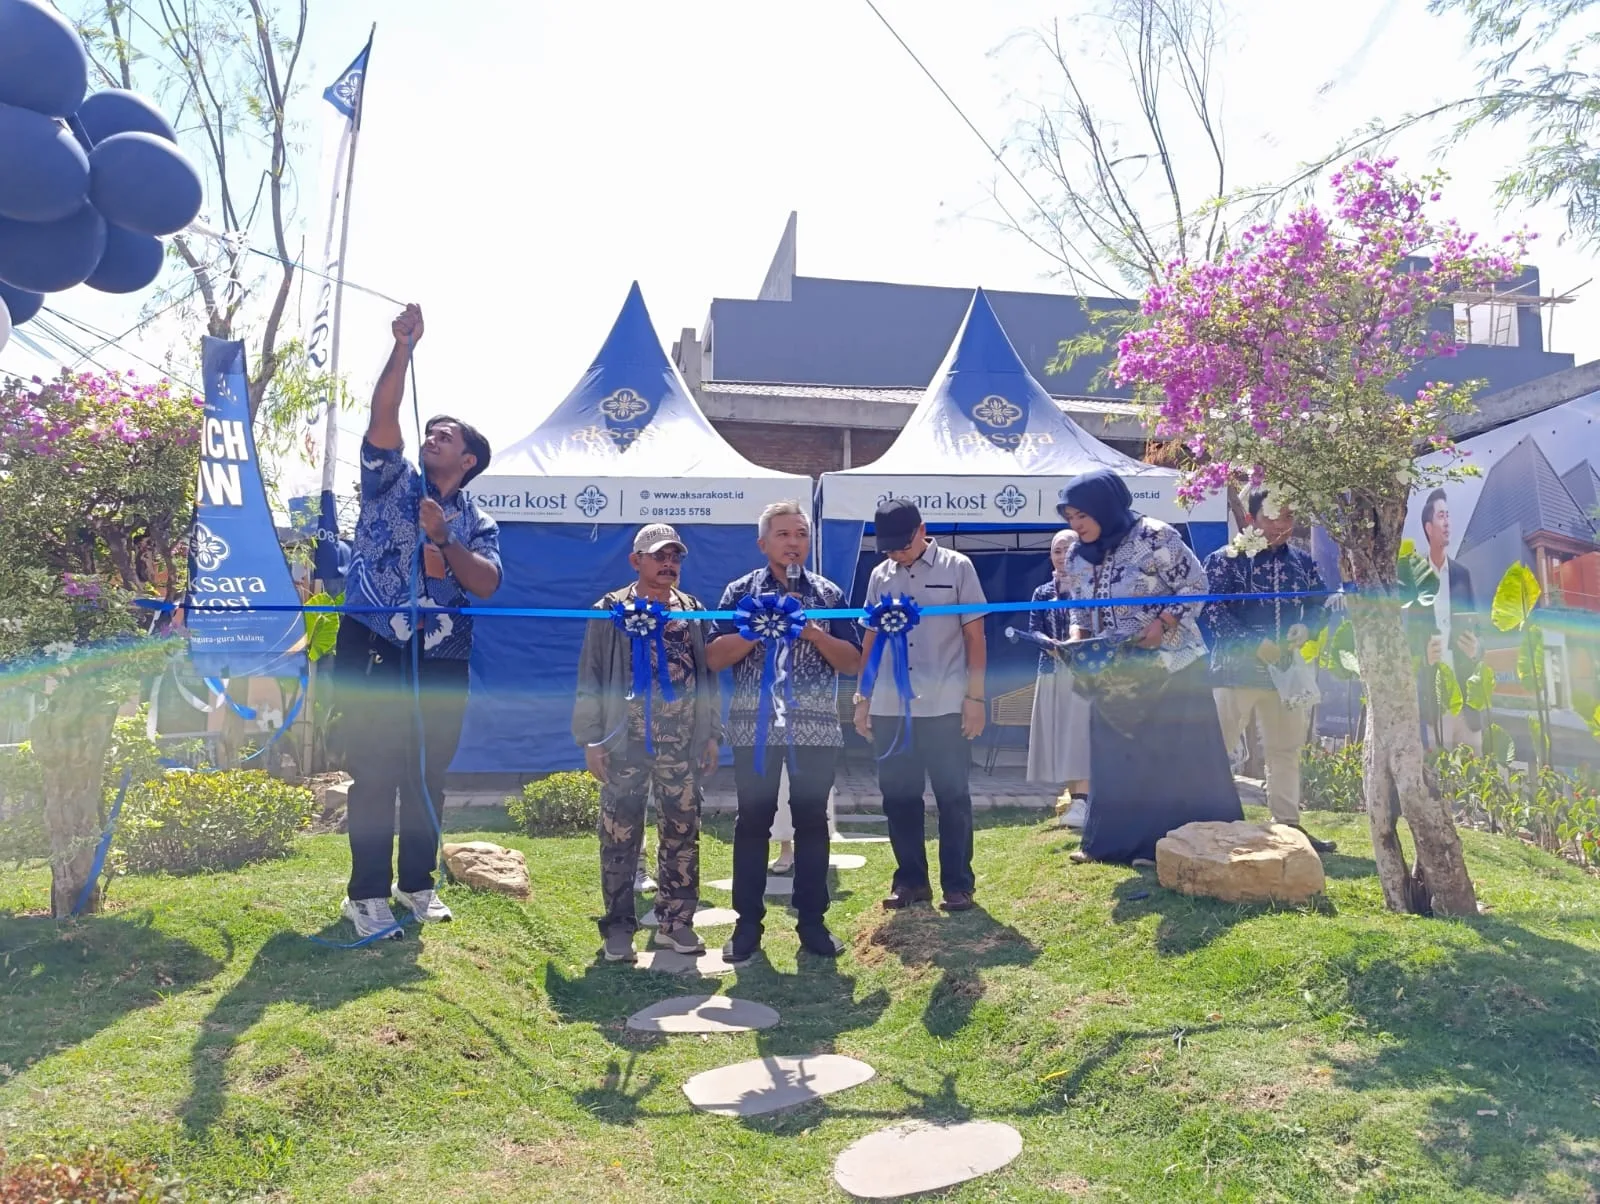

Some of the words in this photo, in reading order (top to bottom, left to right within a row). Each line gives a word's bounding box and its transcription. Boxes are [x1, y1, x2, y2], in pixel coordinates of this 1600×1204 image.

[465, 490, 520, 508] ksara
[525, 491, 568, 509] kost
[653, 490, 744, 500] www.aksarakost.id
[945, 491, 988, 510] kost
[652, 507, 686, 516] 081235
[688, 507, 711, 516] 5758
